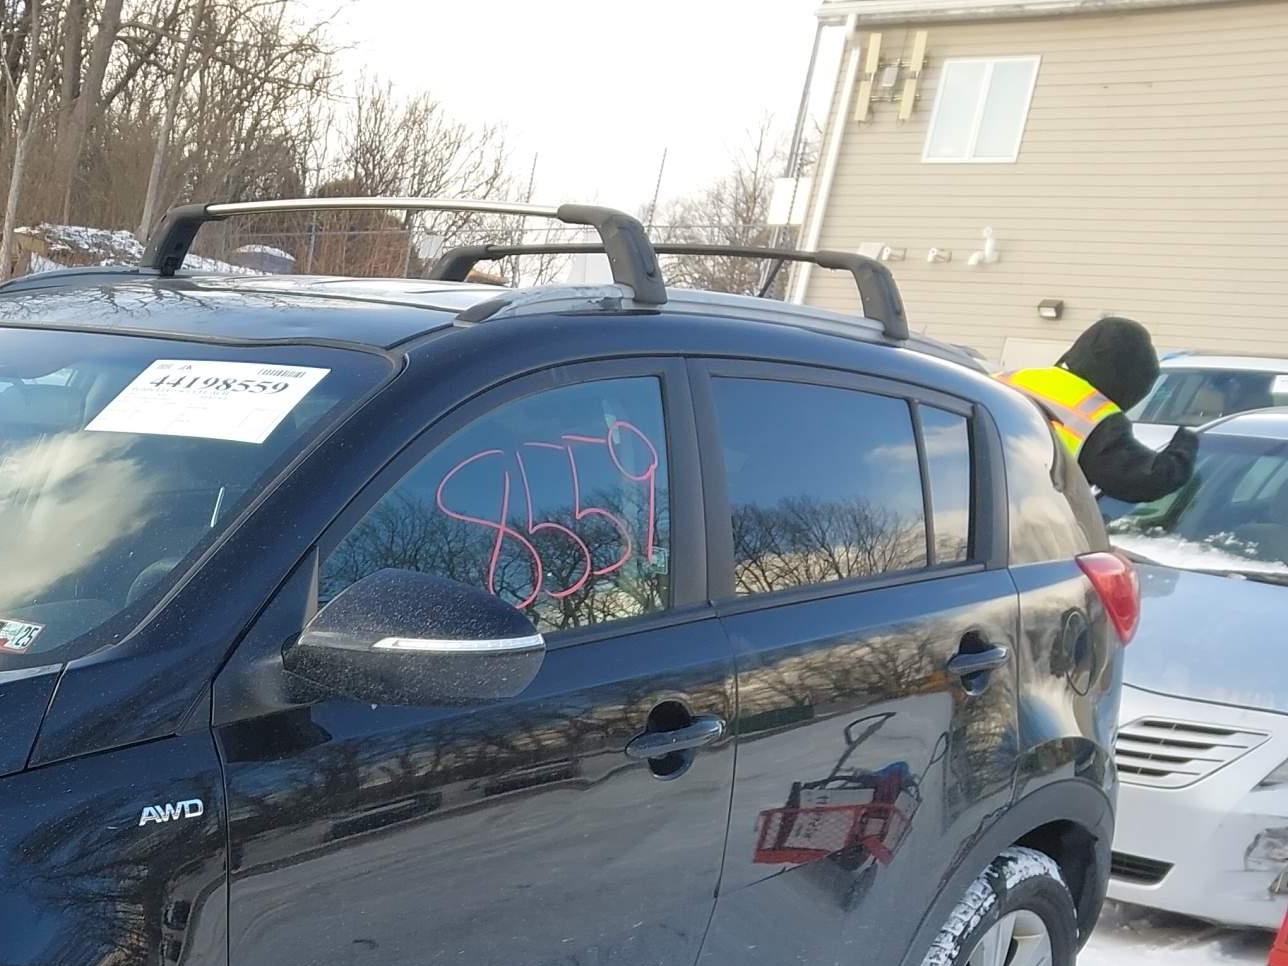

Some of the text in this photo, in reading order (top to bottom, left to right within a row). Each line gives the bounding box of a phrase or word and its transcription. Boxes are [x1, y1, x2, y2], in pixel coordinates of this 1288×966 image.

[149, 374, 290, 395] 44198559
[437, 420, 658, 609] 8559
[14, 625, 39, 647] 25
[138, 798, 204, 826] AWD
